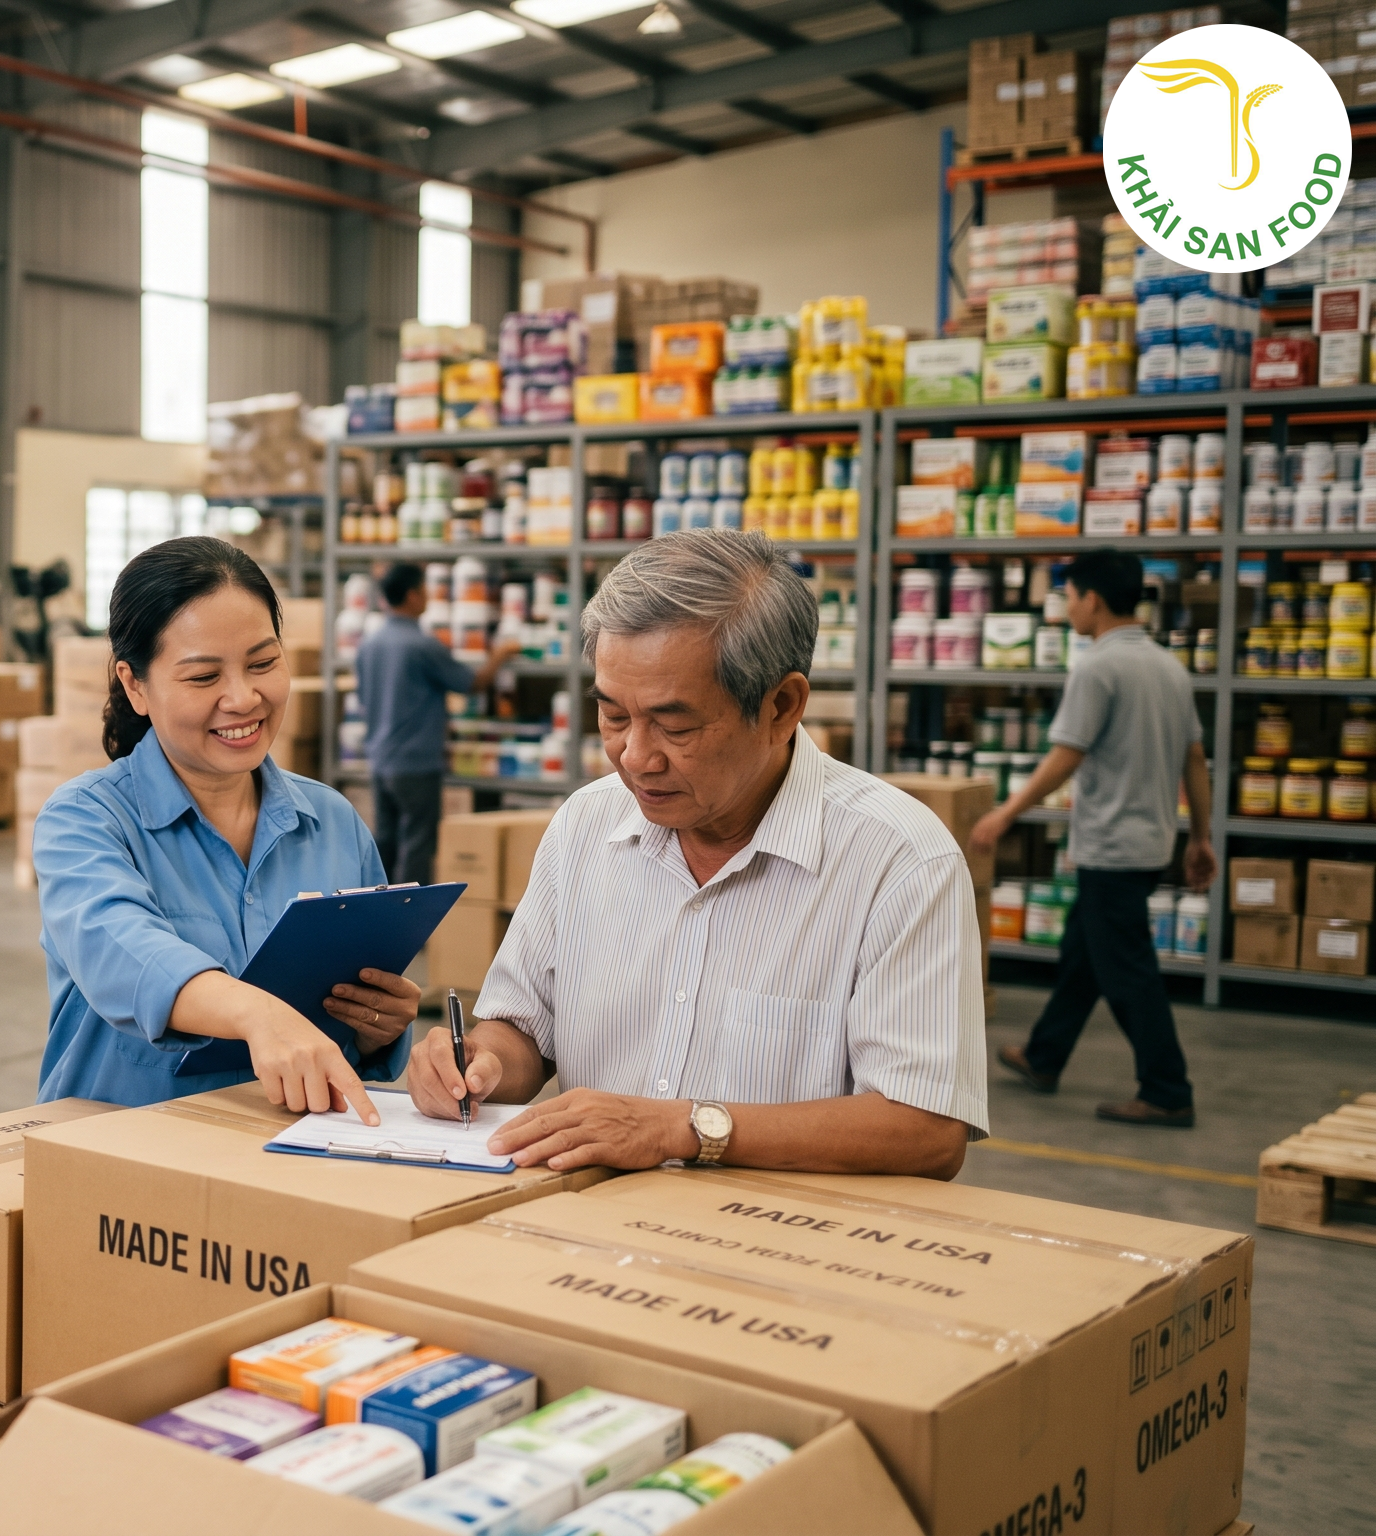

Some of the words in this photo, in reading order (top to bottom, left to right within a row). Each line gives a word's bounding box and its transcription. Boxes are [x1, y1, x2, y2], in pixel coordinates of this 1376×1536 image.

[98, 1213, 189, 1274] MADE
[200, 1237, 232, 1285] IN
[245, 1249, 312, 1298] USA
[717, 1201, 844, 1233] MADE
[845, 1227, 898, 1244] IN
[903, 1237, 994, 1266] USA
[548, 1272, 680, 1312] MADE
[680, 1304, 737, 1326] IN
[740, 1316, 835, 1352] USA
[1137, 1368, 1228, 1474] OMEGA-3
